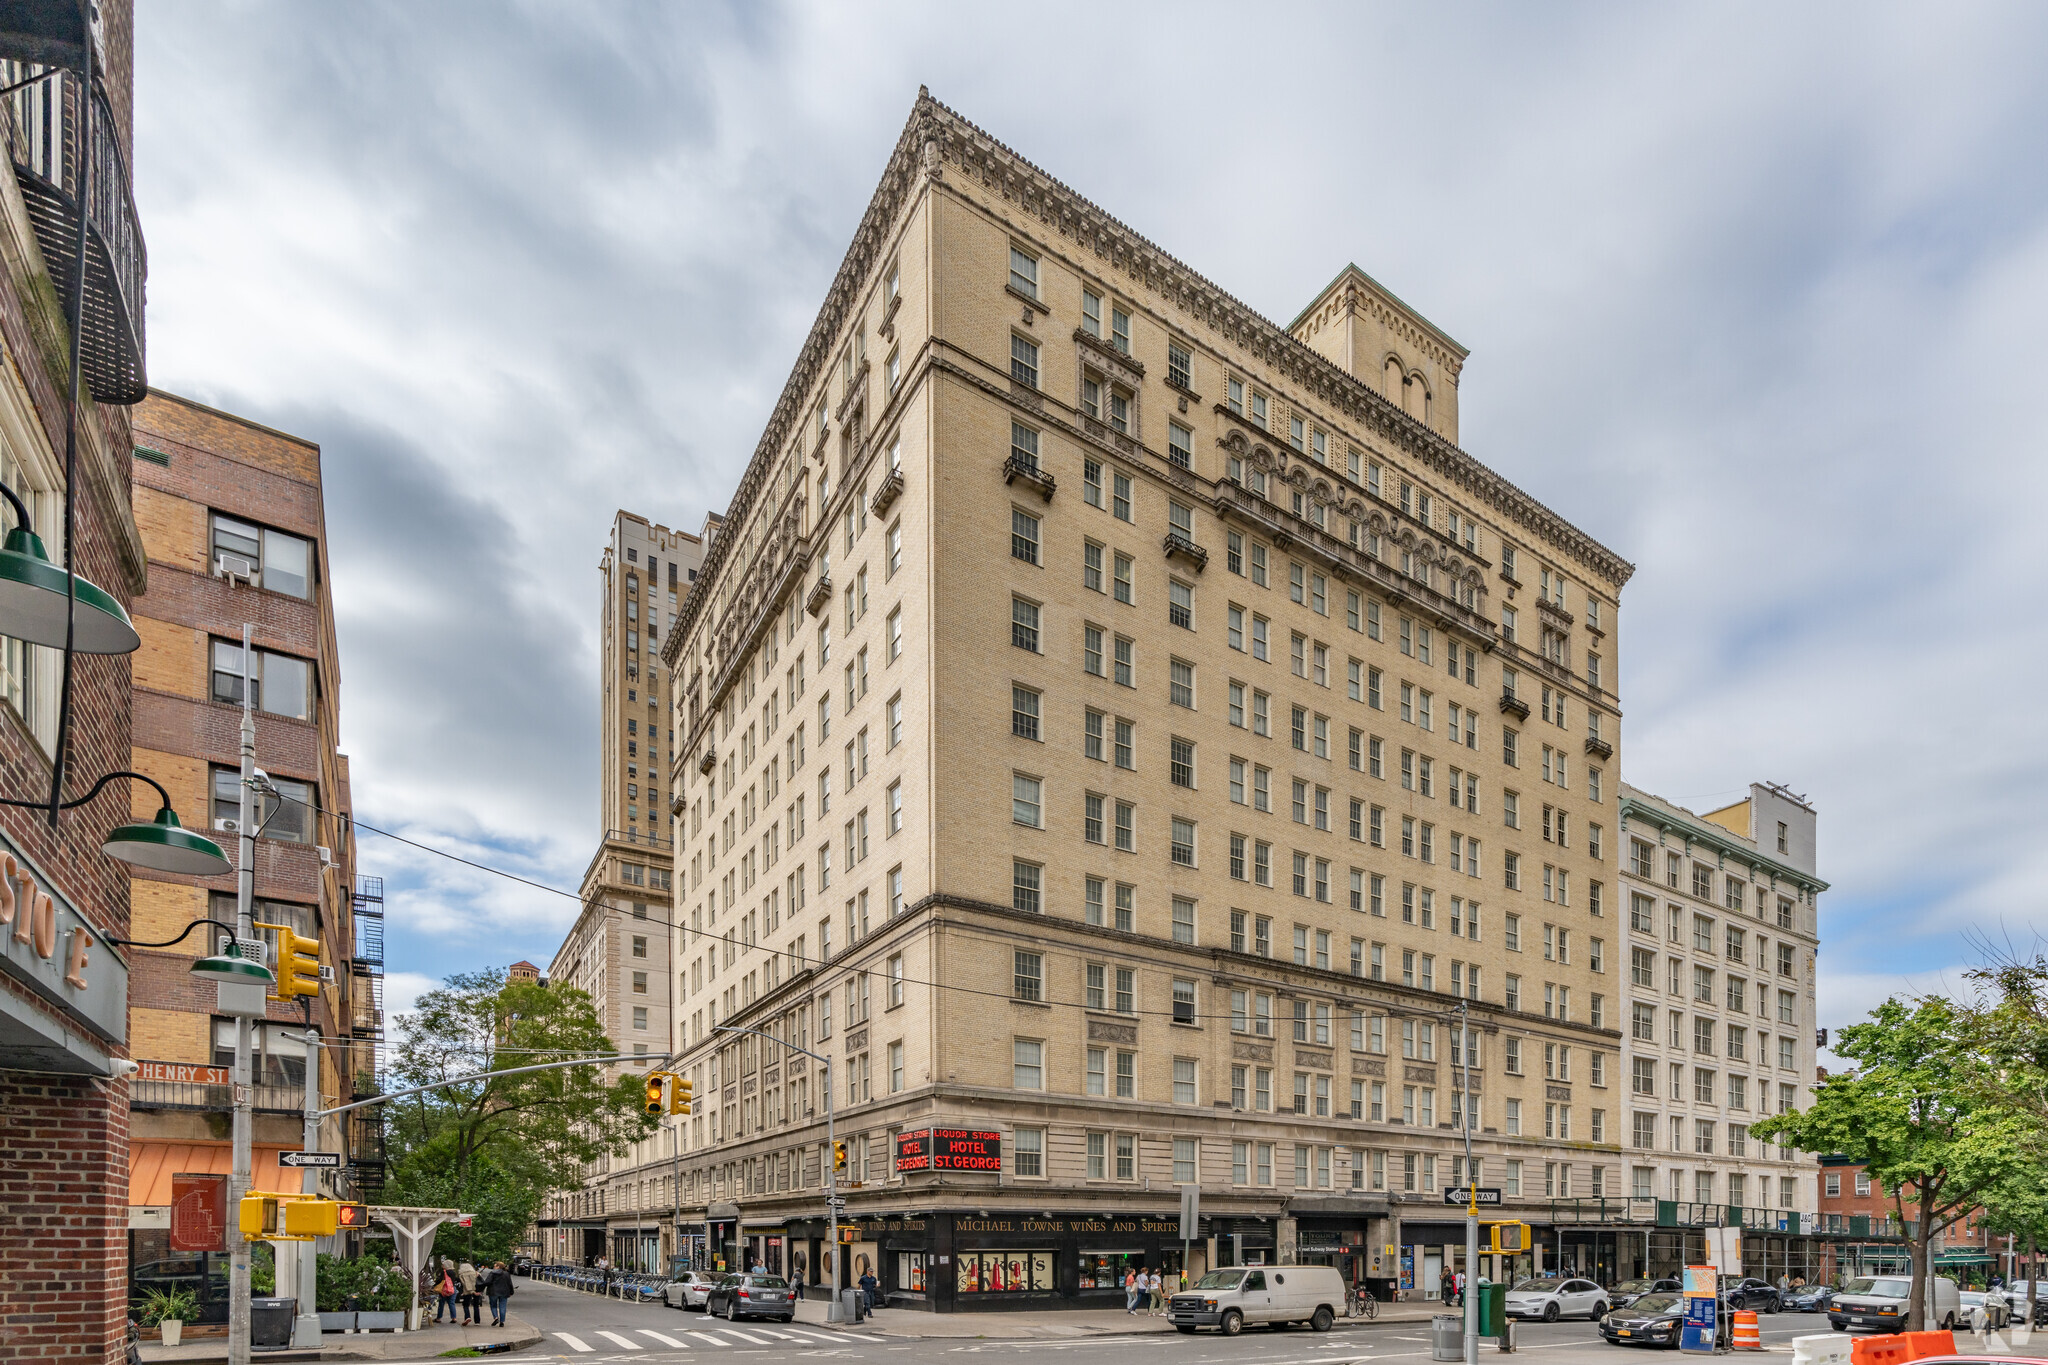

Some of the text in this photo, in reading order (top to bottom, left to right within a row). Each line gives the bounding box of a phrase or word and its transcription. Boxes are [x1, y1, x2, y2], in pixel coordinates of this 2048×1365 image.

[143, 1063, 198, 1081] HENRY
[206, 1068, 225, 1083] ST
[897, 1129, 929, 1143] LIQUOR STORE
[934, 1129, 1000, 1141] LIQUOR STORE
[903, 1142, 921, 1155] HOTEL
[950, 1141, 987, 1154] HOTEL
[935, 1155, 1001, 1169] ST. GEORGE
[1454, 1192, 1471, 1200] ONE
[869, 1222, 886, 1231] WINES
[888, 1221, 901, 1231] AND
[904, 1220, 926, 1231] SPIRITS
[956, 1220, 1178, 1232] MICHAEL TOWNE WINES AND SPIRITS
